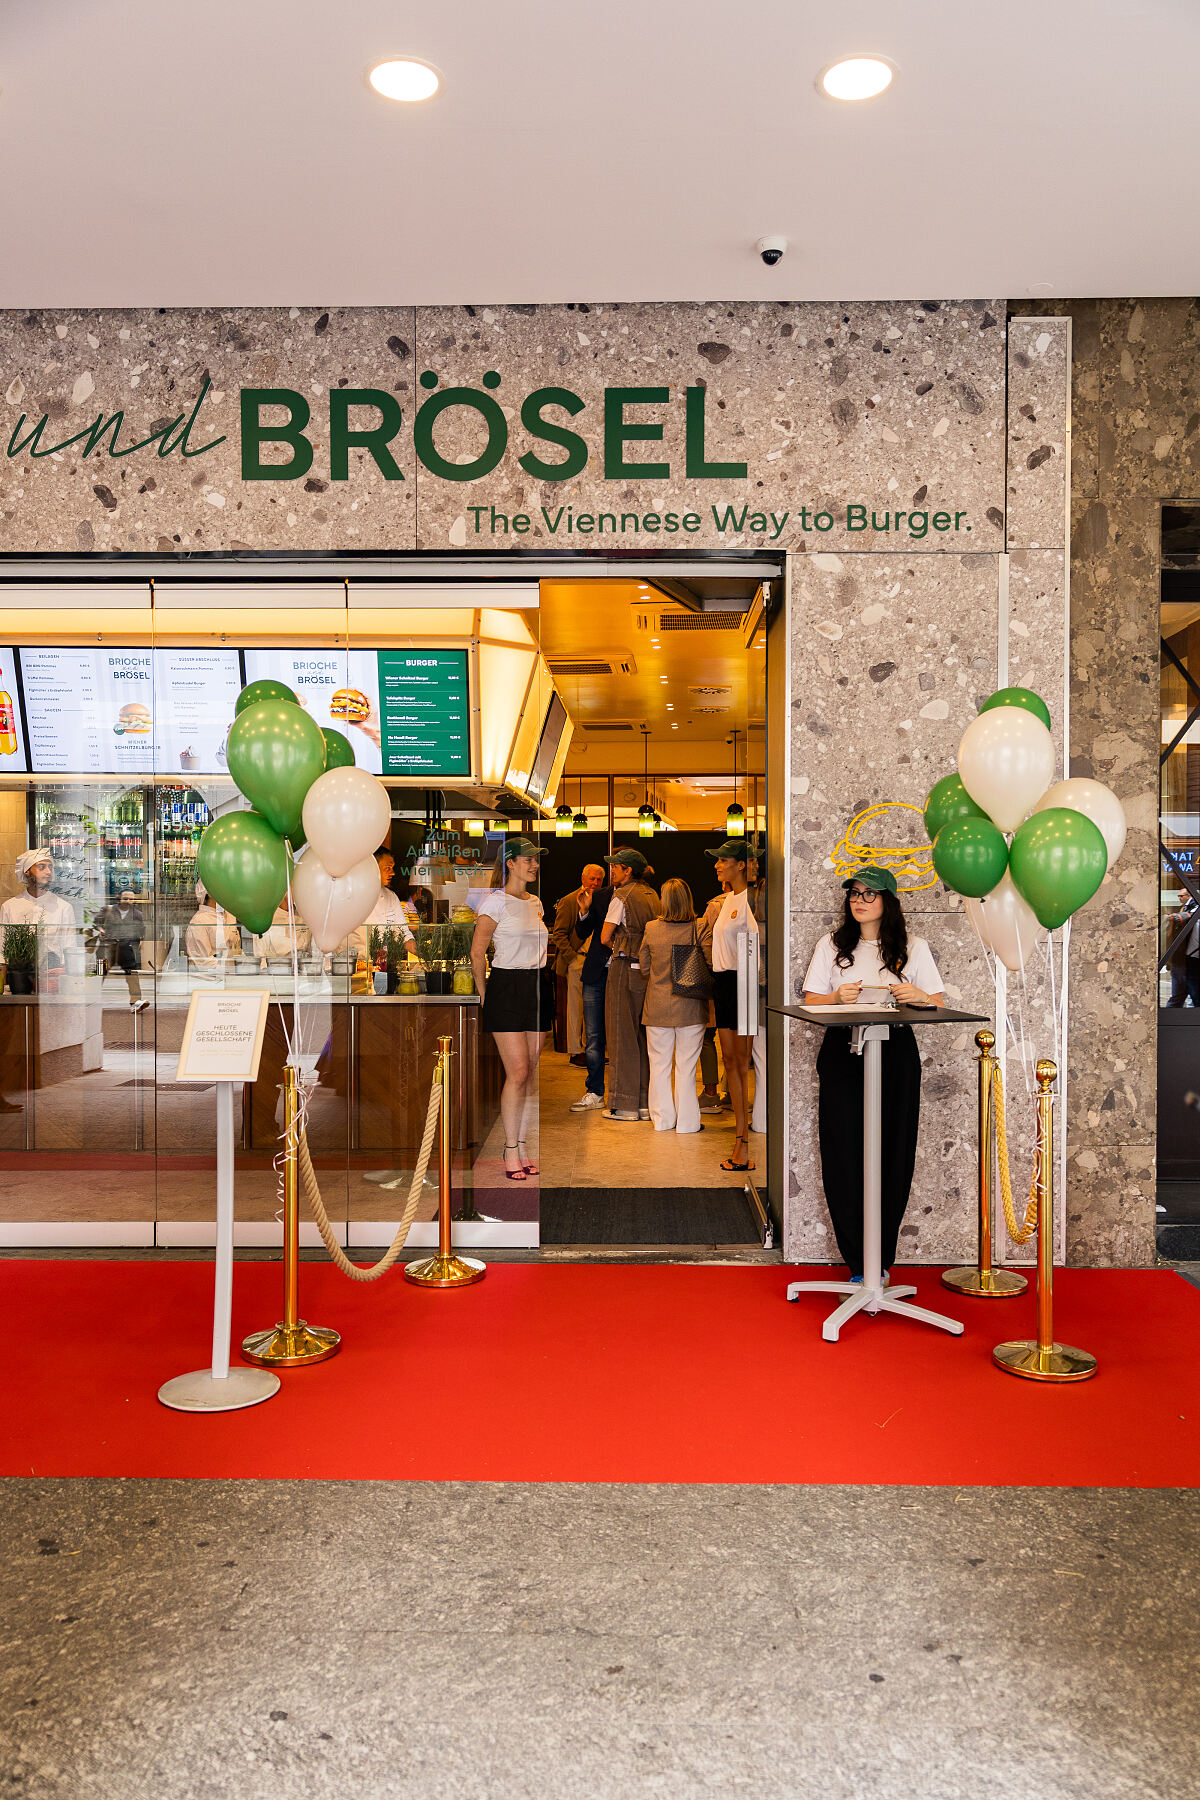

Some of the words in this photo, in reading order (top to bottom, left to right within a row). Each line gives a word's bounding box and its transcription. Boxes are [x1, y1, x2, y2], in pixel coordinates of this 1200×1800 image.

[7, 378, 226, 457] und
[240, 370, 748, 482] BRÖSEL
[466, 505, 531, 534] The
[541, 505, 701, 534] Viennese
[711, 504, 790, 540] Way
[799, 506, 834, 532] to
[846, 504, 972, 539] Burger.
[108, 658, 151, 666] BRIOCHE
[293, 661, 338, 670] BRIOCHE
[405, 659, 438, 667] BURGER
[113, 670, 150, 679] BRÖSEL
[297, 674, 336, 684] BRÖSEL
[426, 828, 461, 841] Zum
[406, 844, 481, 858] Anbeißen
[400, 863, 487, 877] wienerisch.
